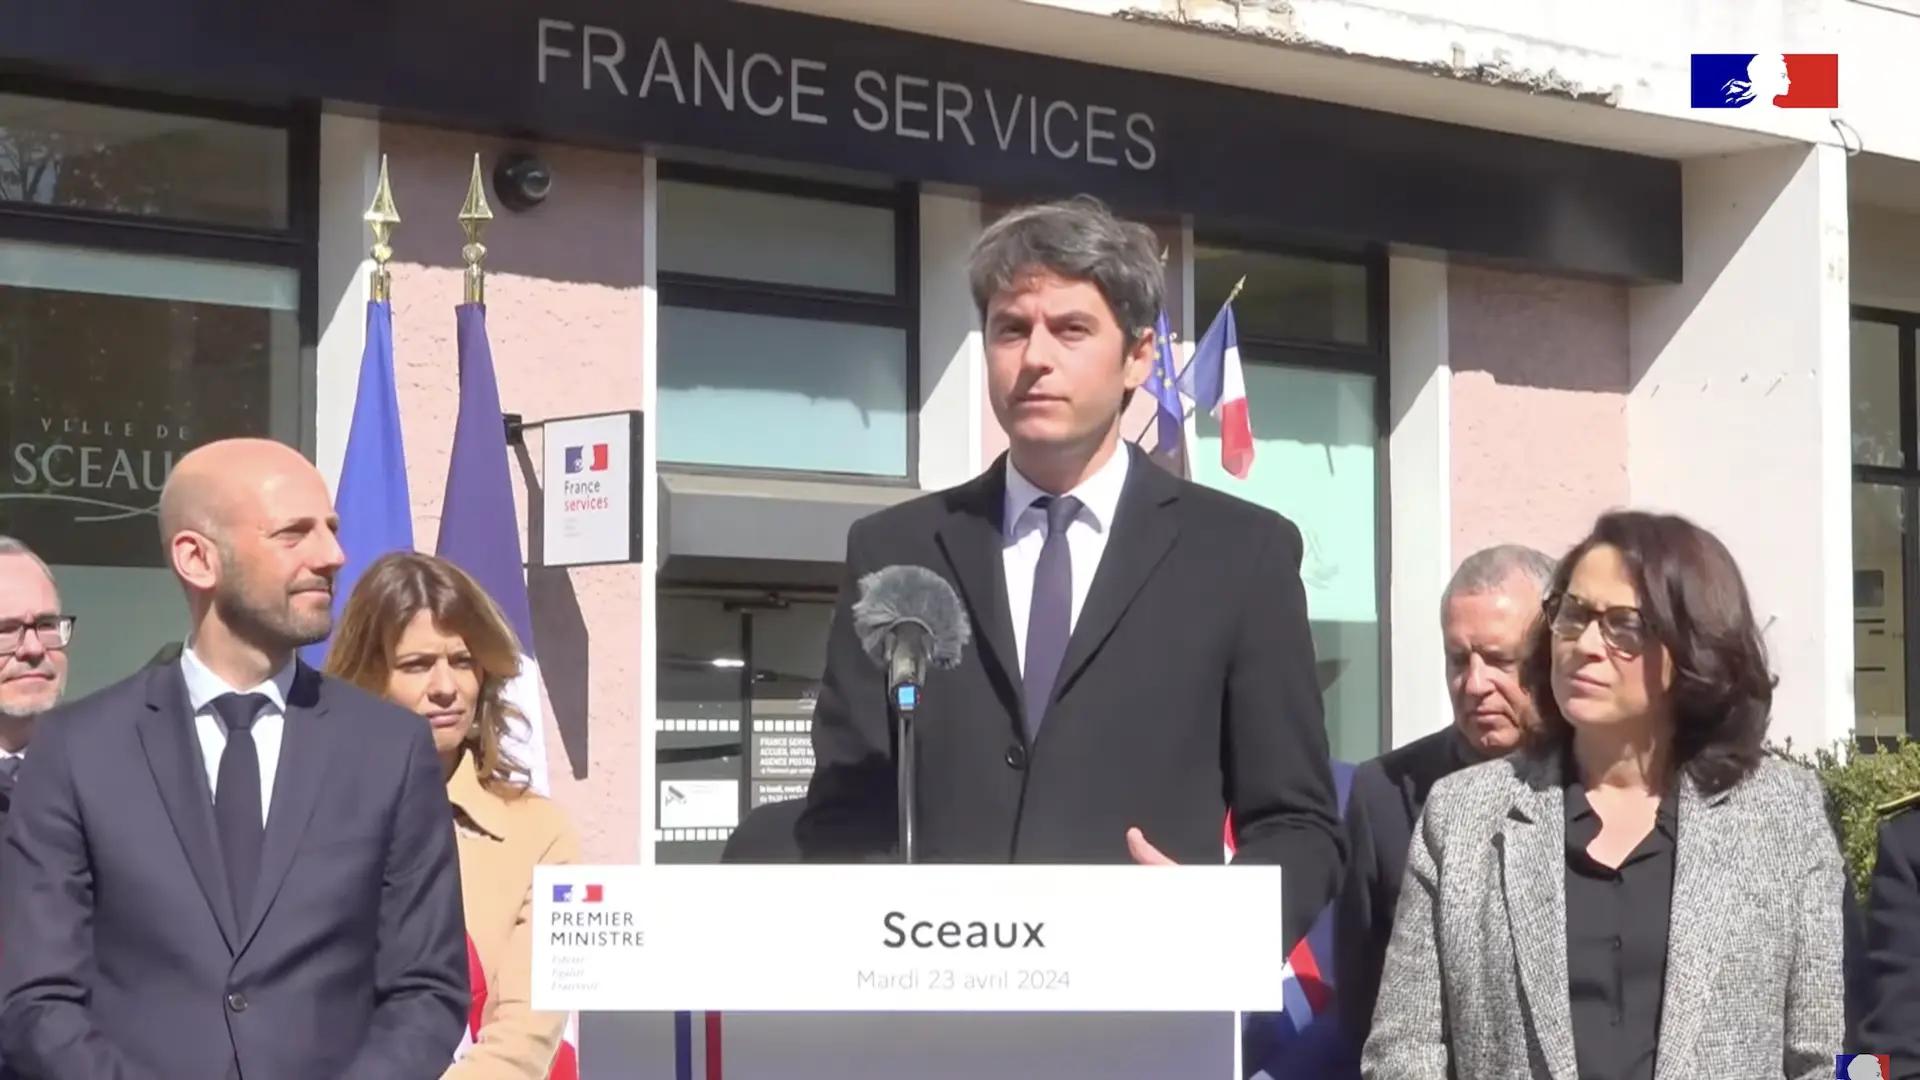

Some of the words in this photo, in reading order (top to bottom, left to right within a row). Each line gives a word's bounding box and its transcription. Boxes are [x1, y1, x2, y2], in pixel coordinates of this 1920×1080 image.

[537, 18, 828, 125] FRANCE
[853, 69, 1157, 170] SERVICES
[41, 416, 135, 438] VILLE
[157, 424, 190, 440] DE
[12, 442, 182, 492] SCEAU
[564, 480, 601, 495] France
[564, 494, 609, 512] services
[788, 737, 813, 746] SERVIC
[788, 757, 816, 766] POSTAL
[551, 911, 634, 927] PREMIER
[550, 930, 645, 947] MINISTRE
[883, 911, 1045, 949] Sceaux
[857, 970, 919, 991] Mardi
[928, 970, 954, 990] 23
[963, 970, 1008, 991] avril
[1017, 970, 1071, 991] 2024
